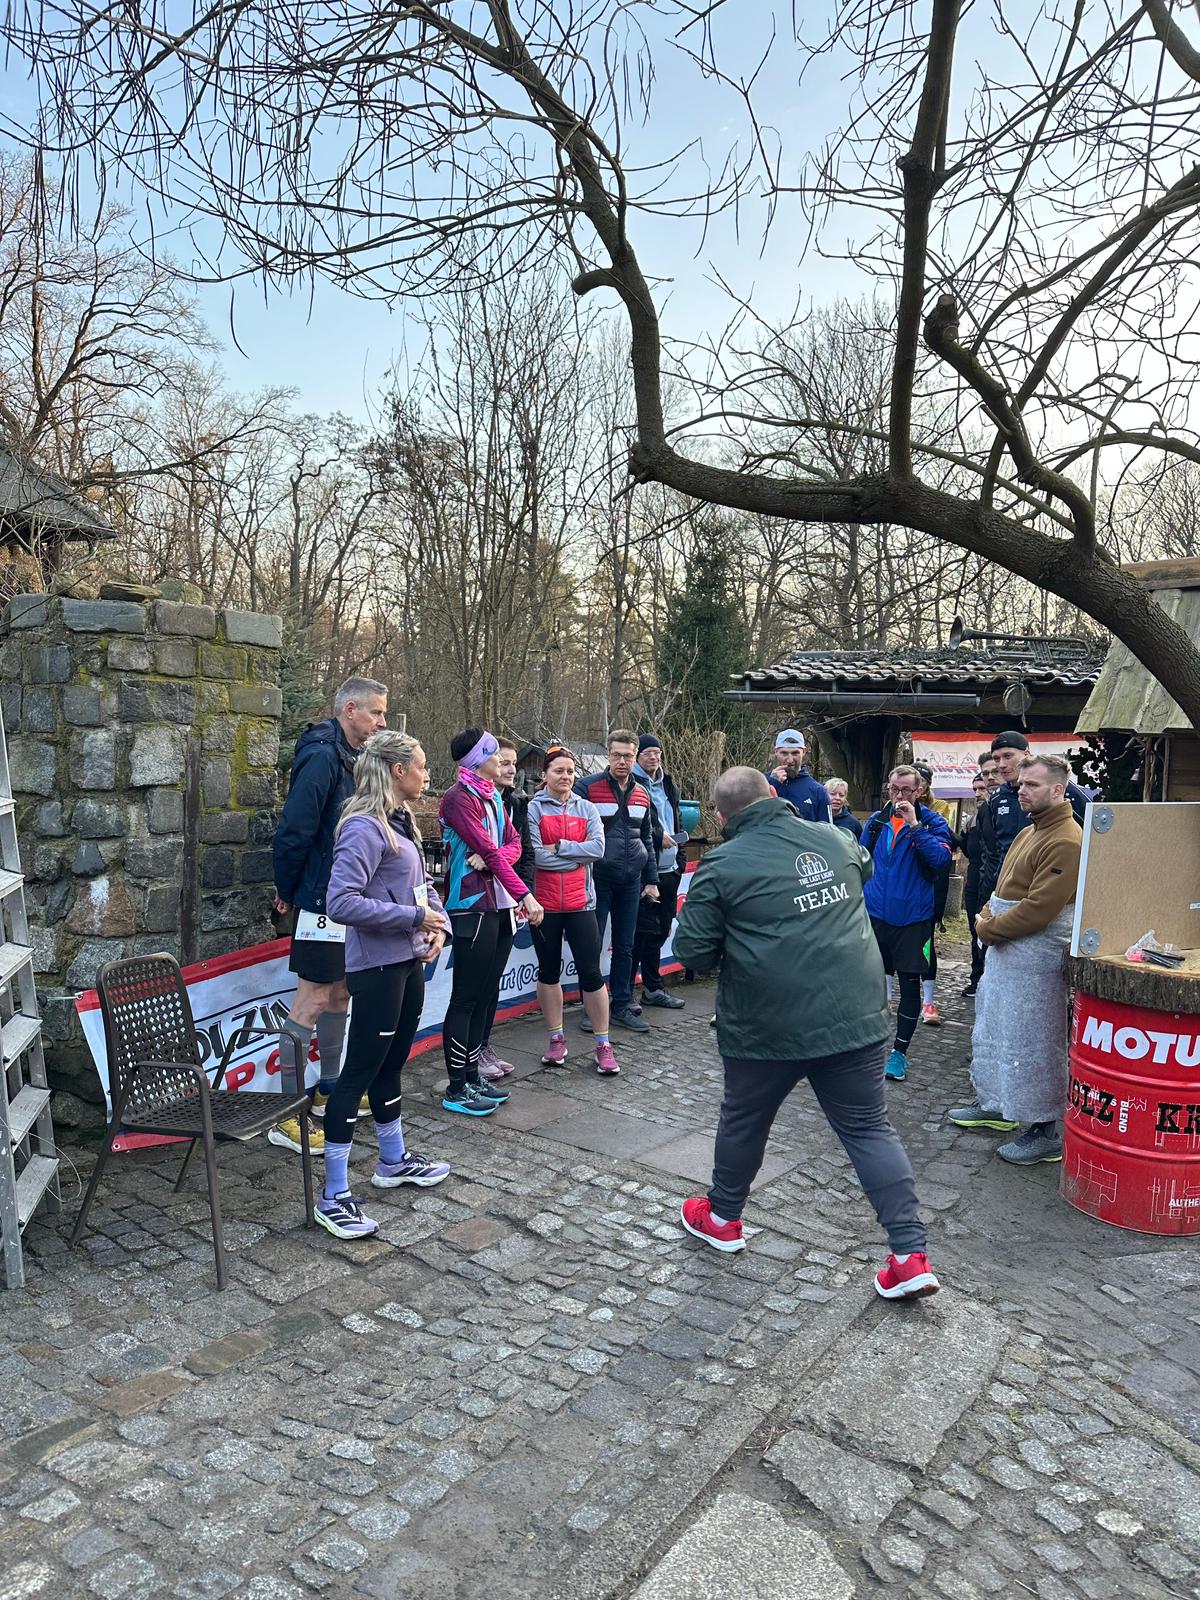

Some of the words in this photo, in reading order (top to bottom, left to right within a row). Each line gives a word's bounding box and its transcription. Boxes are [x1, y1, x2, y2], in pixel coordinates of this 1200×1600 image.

[809, 875, 820, 883] LAST
[793, 883, 849, 912] TEAM
[317, 915, 327, 929] 8
[1081, 1015, 1200, 1067] MOTU
[1118, 1100, 1130, 1133] BLEND
